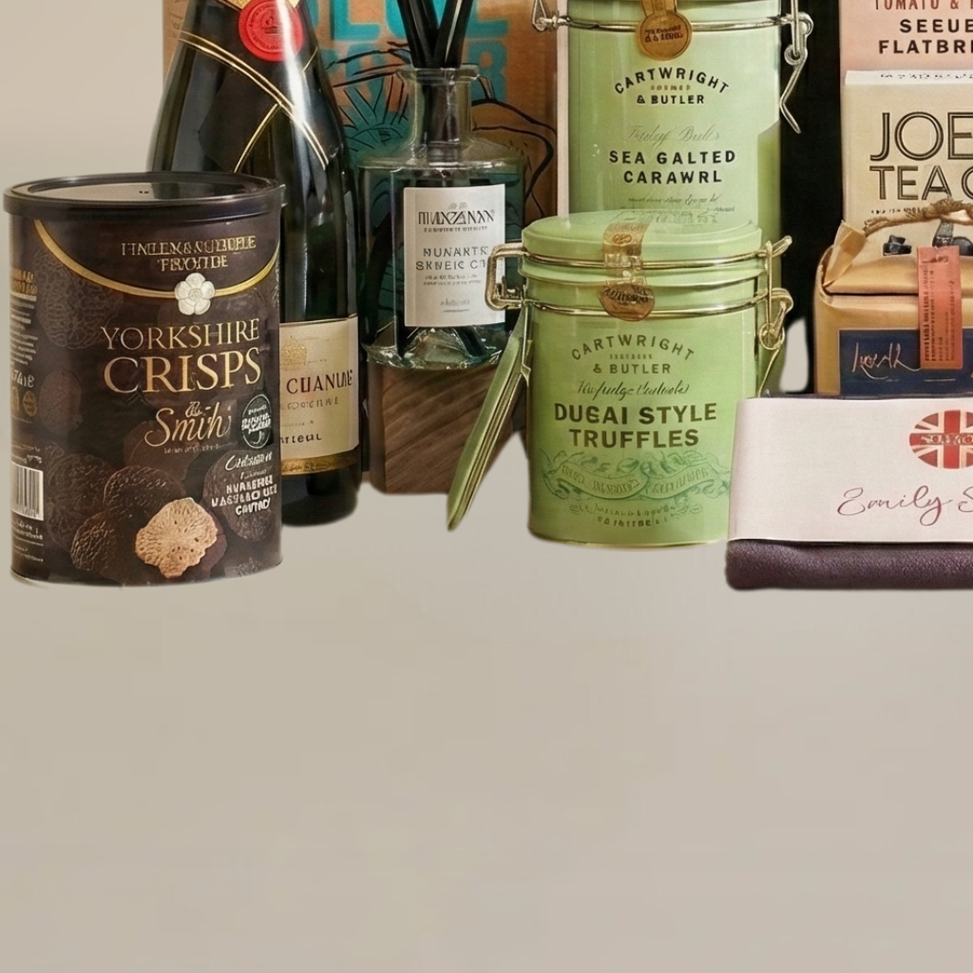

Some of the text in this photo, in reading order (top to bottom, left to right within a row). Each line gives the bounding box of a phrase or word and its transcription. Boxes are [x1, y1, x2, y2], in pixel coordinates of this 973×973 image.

[613, 66, 730, 95] CARTWRIGHT
[636, 94, 705, 105] & BUTLER
[608, 149, 646, 165] SEA
[869, 164, 953, 202] TEA
[102, 318, 260, 351] YORKSHIRE
[571, 333, 694, 362] CARTWRIGHT
[103, 346, 262, 394] CRISPS
[609, 363, 672, 375] BUTLER
[637, 402, 718, 426] STYLE
[568, 428, 700, 449] TRUFFLES
